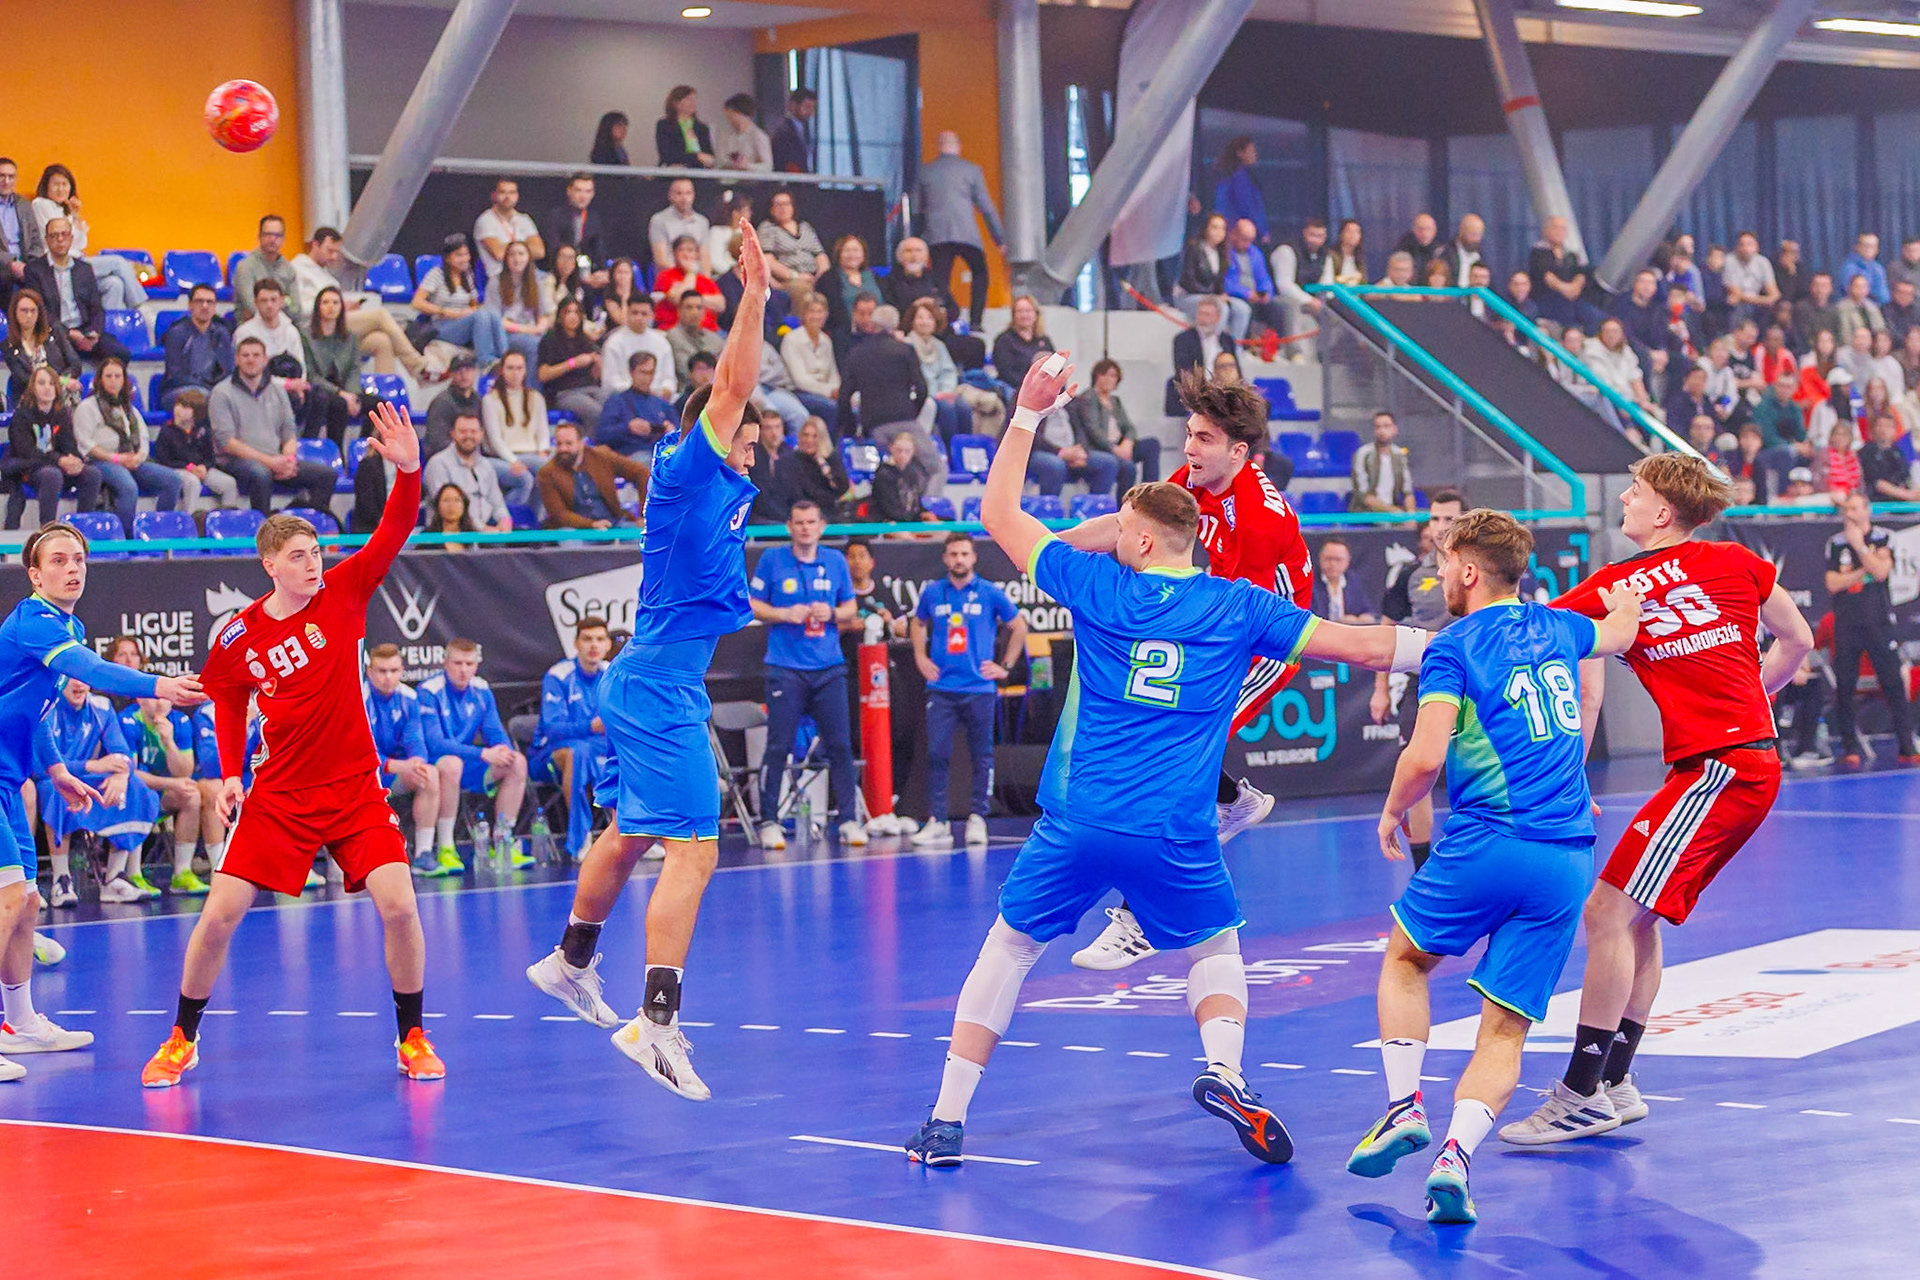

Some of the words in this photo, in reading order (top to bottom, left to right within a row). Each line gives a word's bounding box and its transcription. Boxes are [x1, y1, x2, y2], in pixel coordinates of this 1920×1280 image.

[121, 611, 194, 636] LIGUE
[560, 588, 633, 627] Serr
[1019, 607, 1073, 630] arn
[94, 634, 195, 658] FNCE
[267, 635, 309, 678] 93
[1644, 622, 1743, 662] MAGYARORSZÁG
[1124, 639, 1184, 708] 2
[1502, 660, 1581, 742] 18
